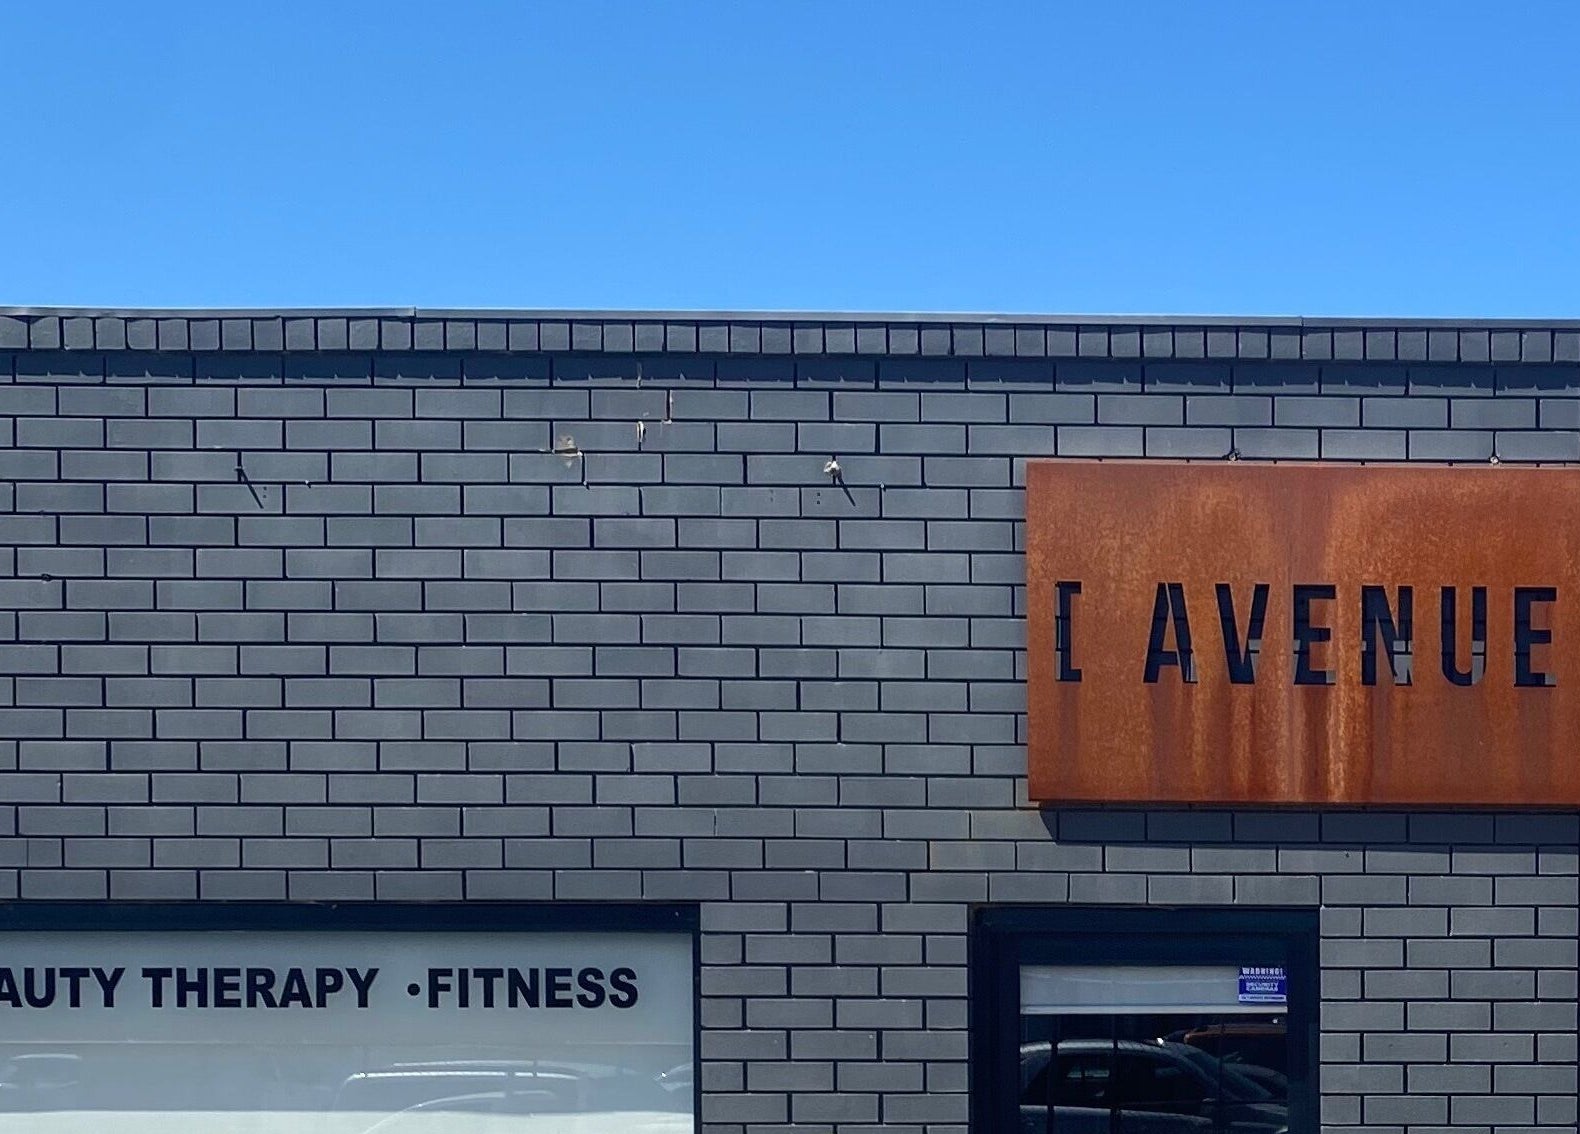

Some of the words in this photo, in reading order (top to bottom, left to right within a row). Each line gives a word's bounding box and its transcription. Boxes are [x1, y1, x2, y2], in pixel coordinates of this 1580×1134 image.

[1142, 582, 1557, 689] AVENUE
[0, 967, 126, 1009] AUTY
[141, 967, 380, 1009] THERAPY
[427, 967, 639, 1009] FITNESS
